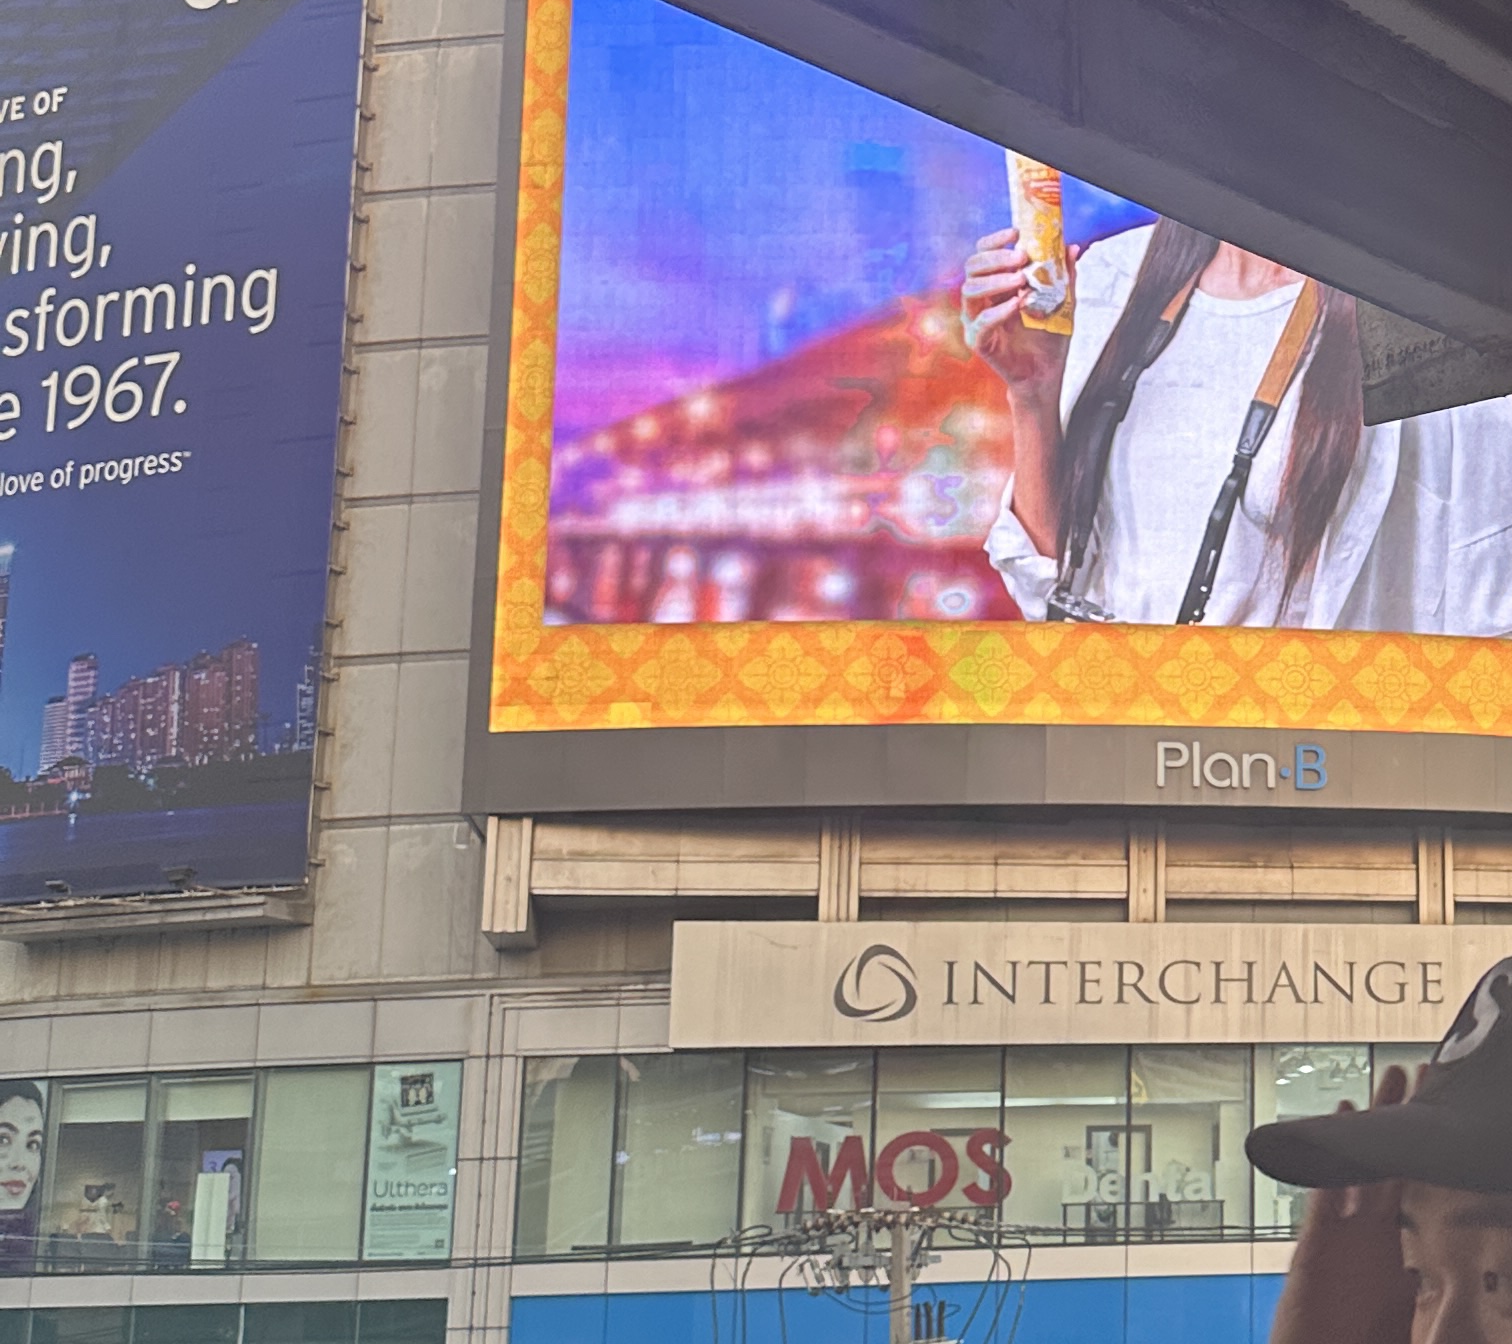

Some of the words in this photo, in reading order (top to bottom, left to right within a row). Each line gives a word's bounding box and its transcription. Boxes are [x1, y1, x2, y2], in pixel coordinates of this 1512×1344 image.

[33, 87, 68, 115] OF
[2, 264, 277, 356] sforming
[41, 352, 187, 432] 1967.
[50, 460, 75, 487] of
[1156, 741, 1277, 788] Plan
[943, 960, 1444, 1005] INTERCHANGE
[373, 1180, 448, 1198] Ulthera
[776, 1128, 1012, 1214] MOS
